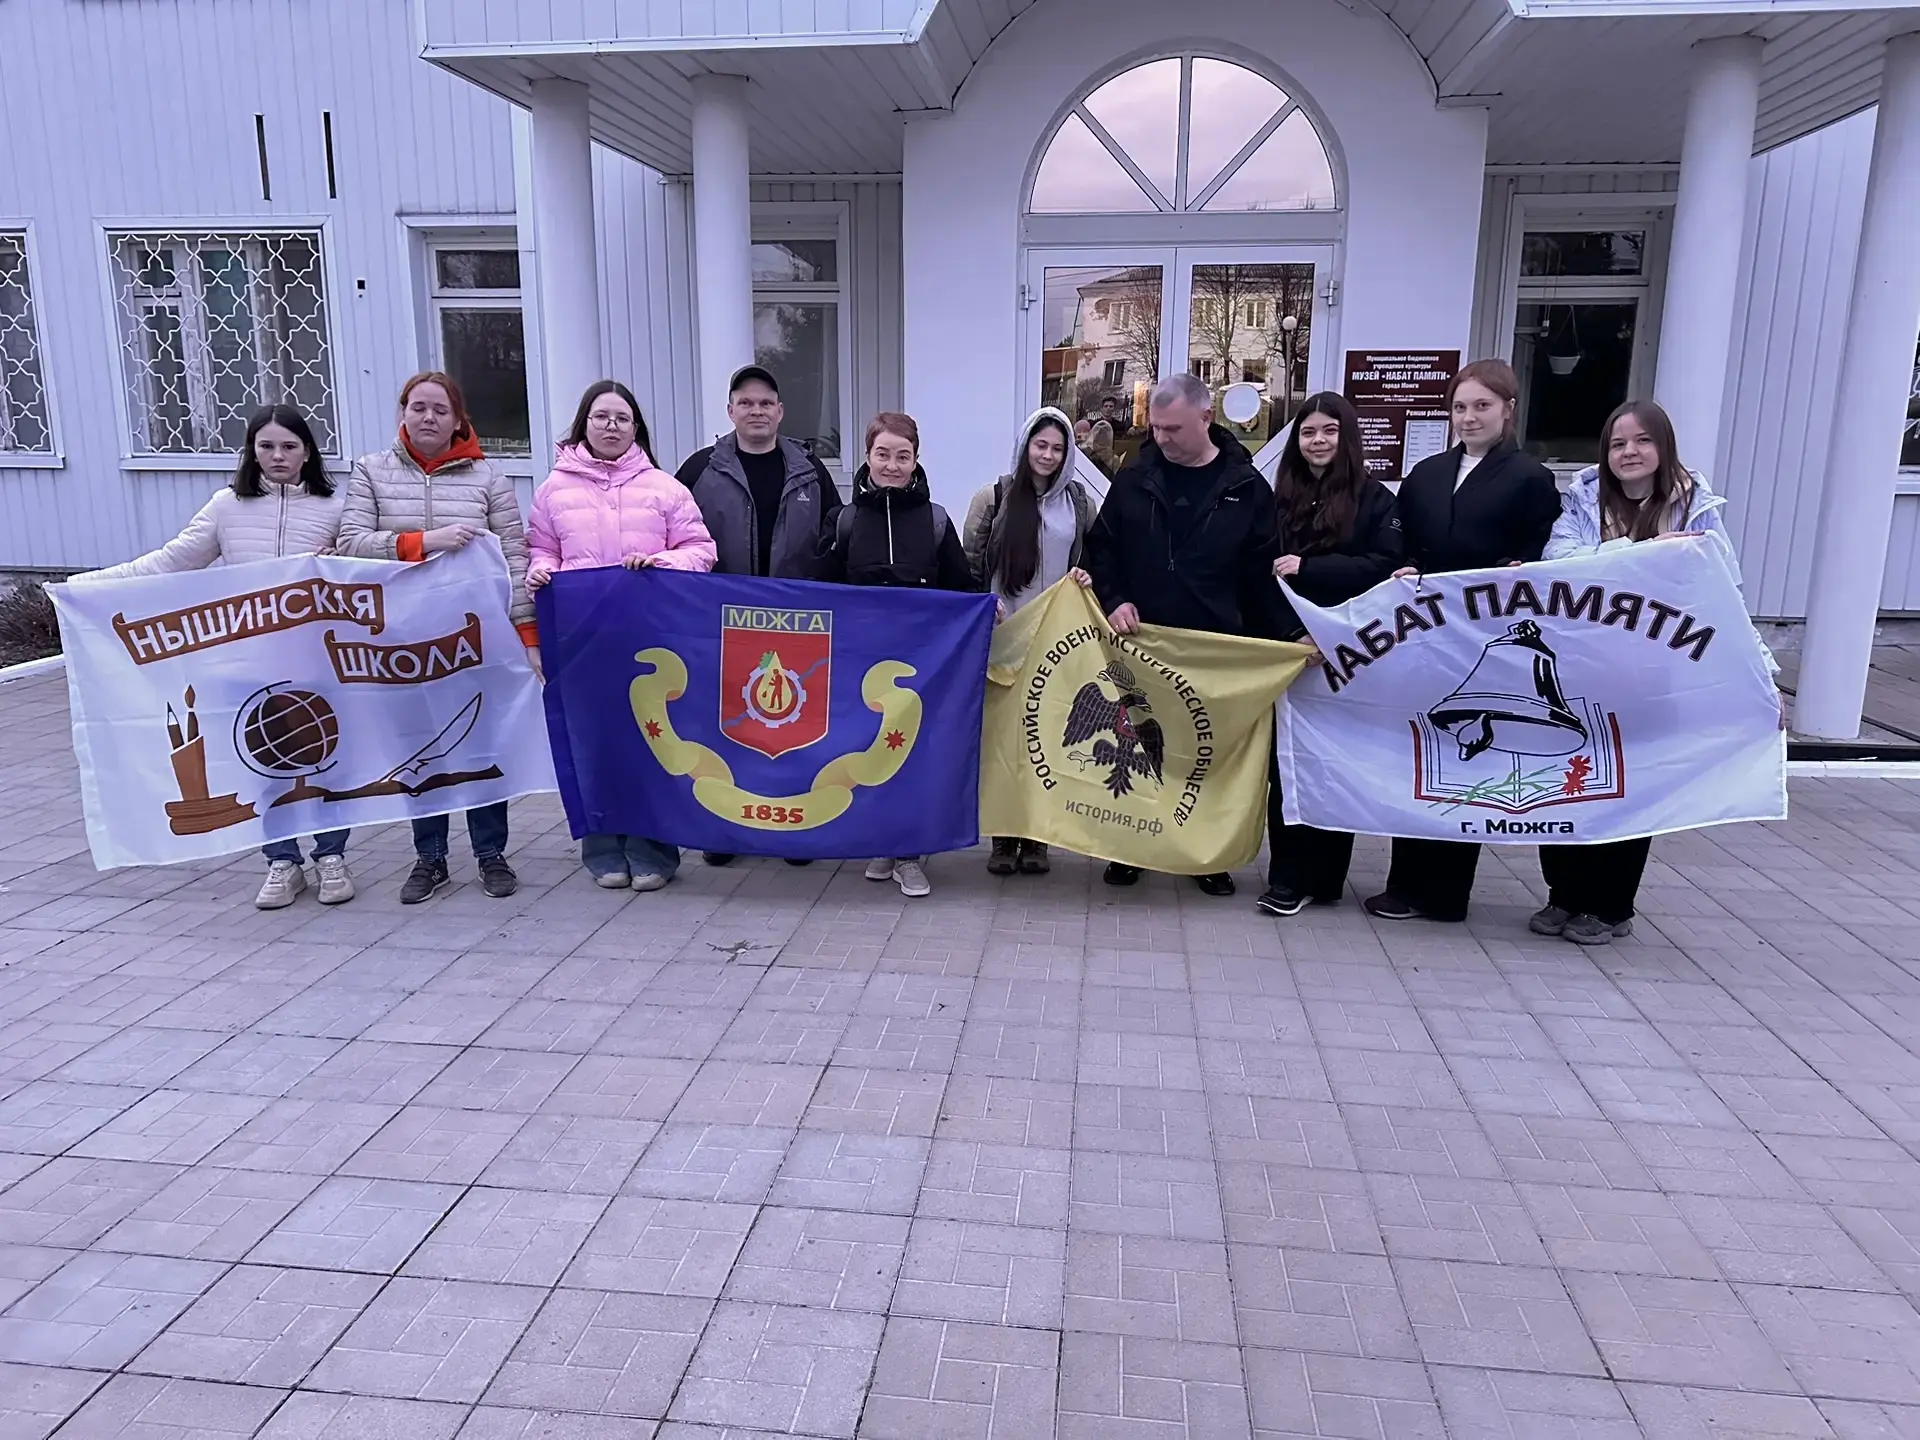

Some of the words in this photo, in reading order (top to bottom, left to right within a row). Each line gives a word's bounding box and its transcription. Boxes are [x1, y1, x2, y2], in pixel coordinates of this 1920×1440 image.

[1352, 370, 1380, 380] МУЗЕЙ
[729, 607, 826, 632] МОЖГА
[1462, 579, 1716, 663] ПАМЯТИ
[337, 635, 479, 679] ШКОЛА
[1022, 664, 1057, 791] РОССИЙСКОЕ
[1173, 746, 1214, 828] ОБЩЕСТВО
[740, 804, 804, 824] 1835
[1065, 799, 1164, 836] история.рф
[1460, 822, 1478, 834] г.
[1485, 817, 1575, 836] Можга
